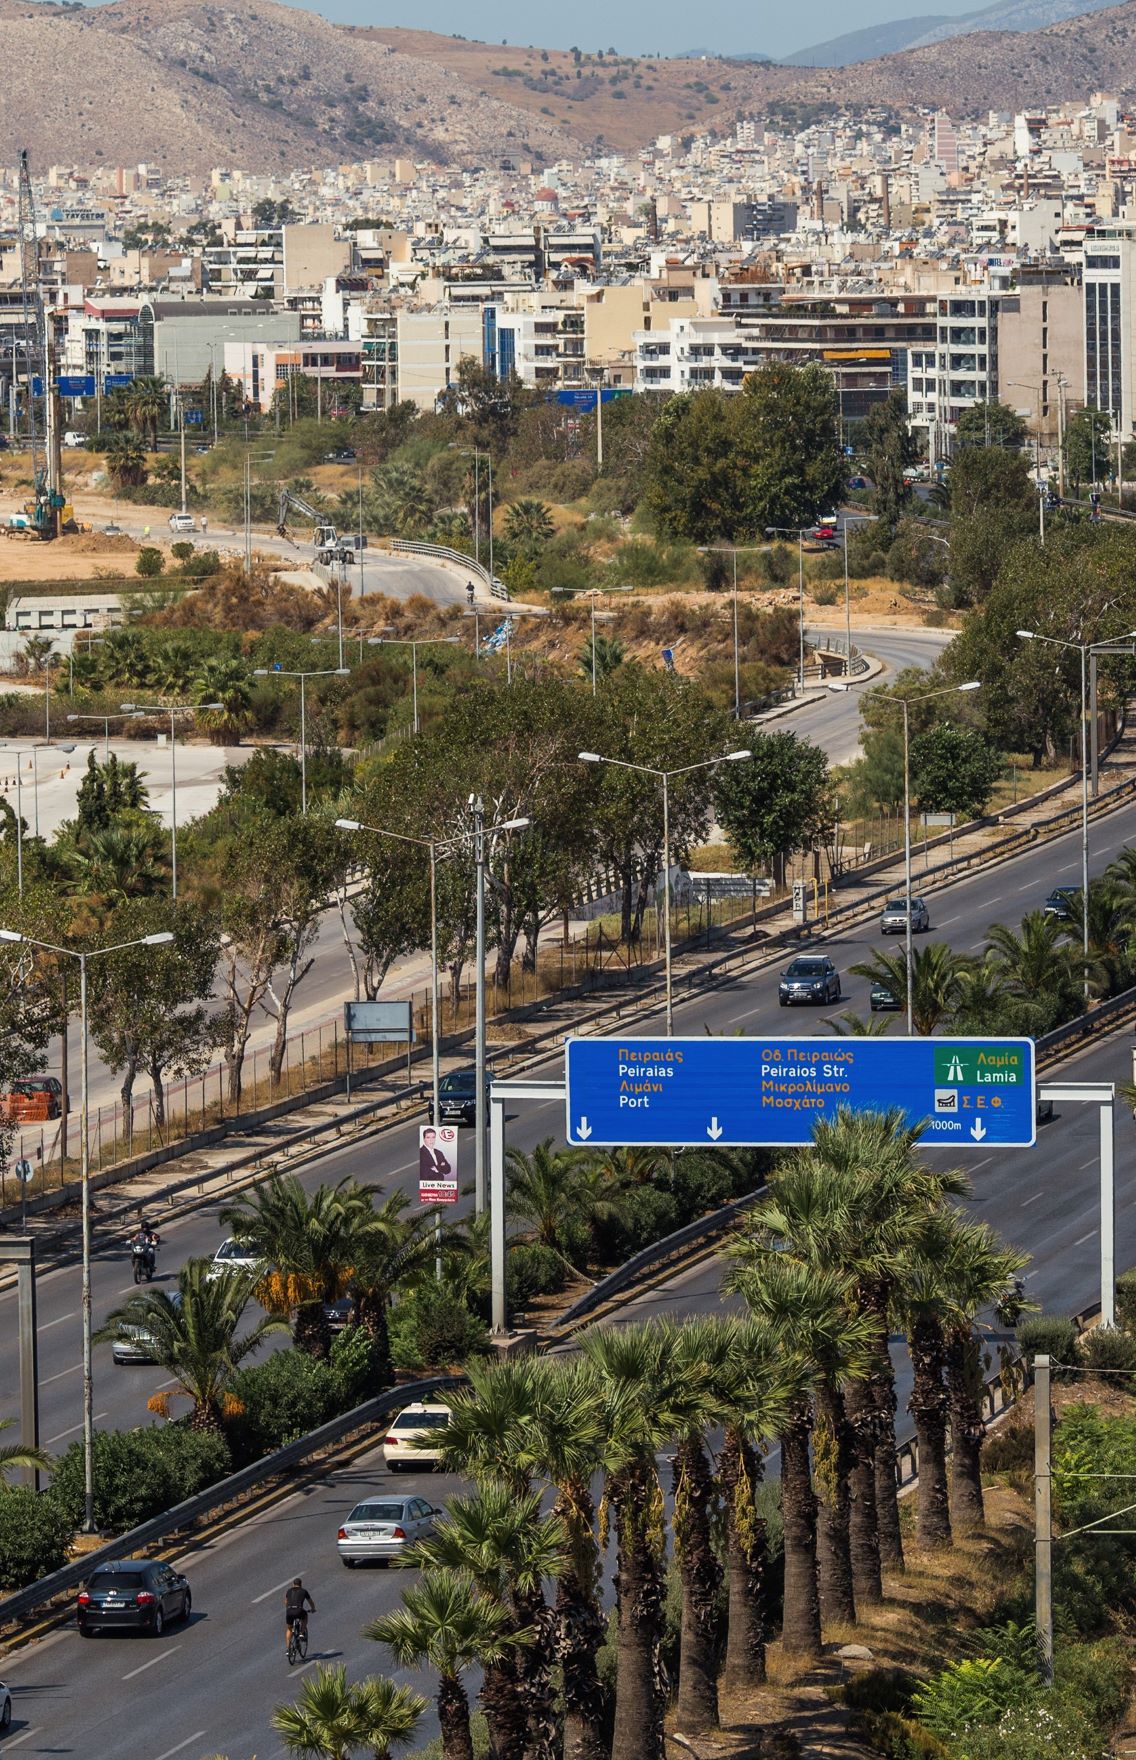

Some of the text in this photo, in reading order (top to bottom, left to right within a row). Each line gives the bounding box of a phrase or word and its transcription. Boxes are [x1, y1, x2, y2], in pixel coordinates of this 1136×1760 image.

[618, 1049, 684, 1063] Πειραιάς
[787, 1048, 854, 1063] Πειραιώς
[977, 1052, 1018, 1067] Λαμία
[618, 1065, 674, 1077] Peiraias
[761, 1065, 848, 1077] Peiraios Str.
[976, 1070, 1017, 1082] Lamia
[619, 1080, 663, 1094] Λιμάνι
[761, 1080, 850, 1094] Μικρολίμανο
[619, 1096, 650, 1107] Port
[762, 1095, 825, 1110] Μοσχάτο
[931, 1120, 961, 1130] 1000m
